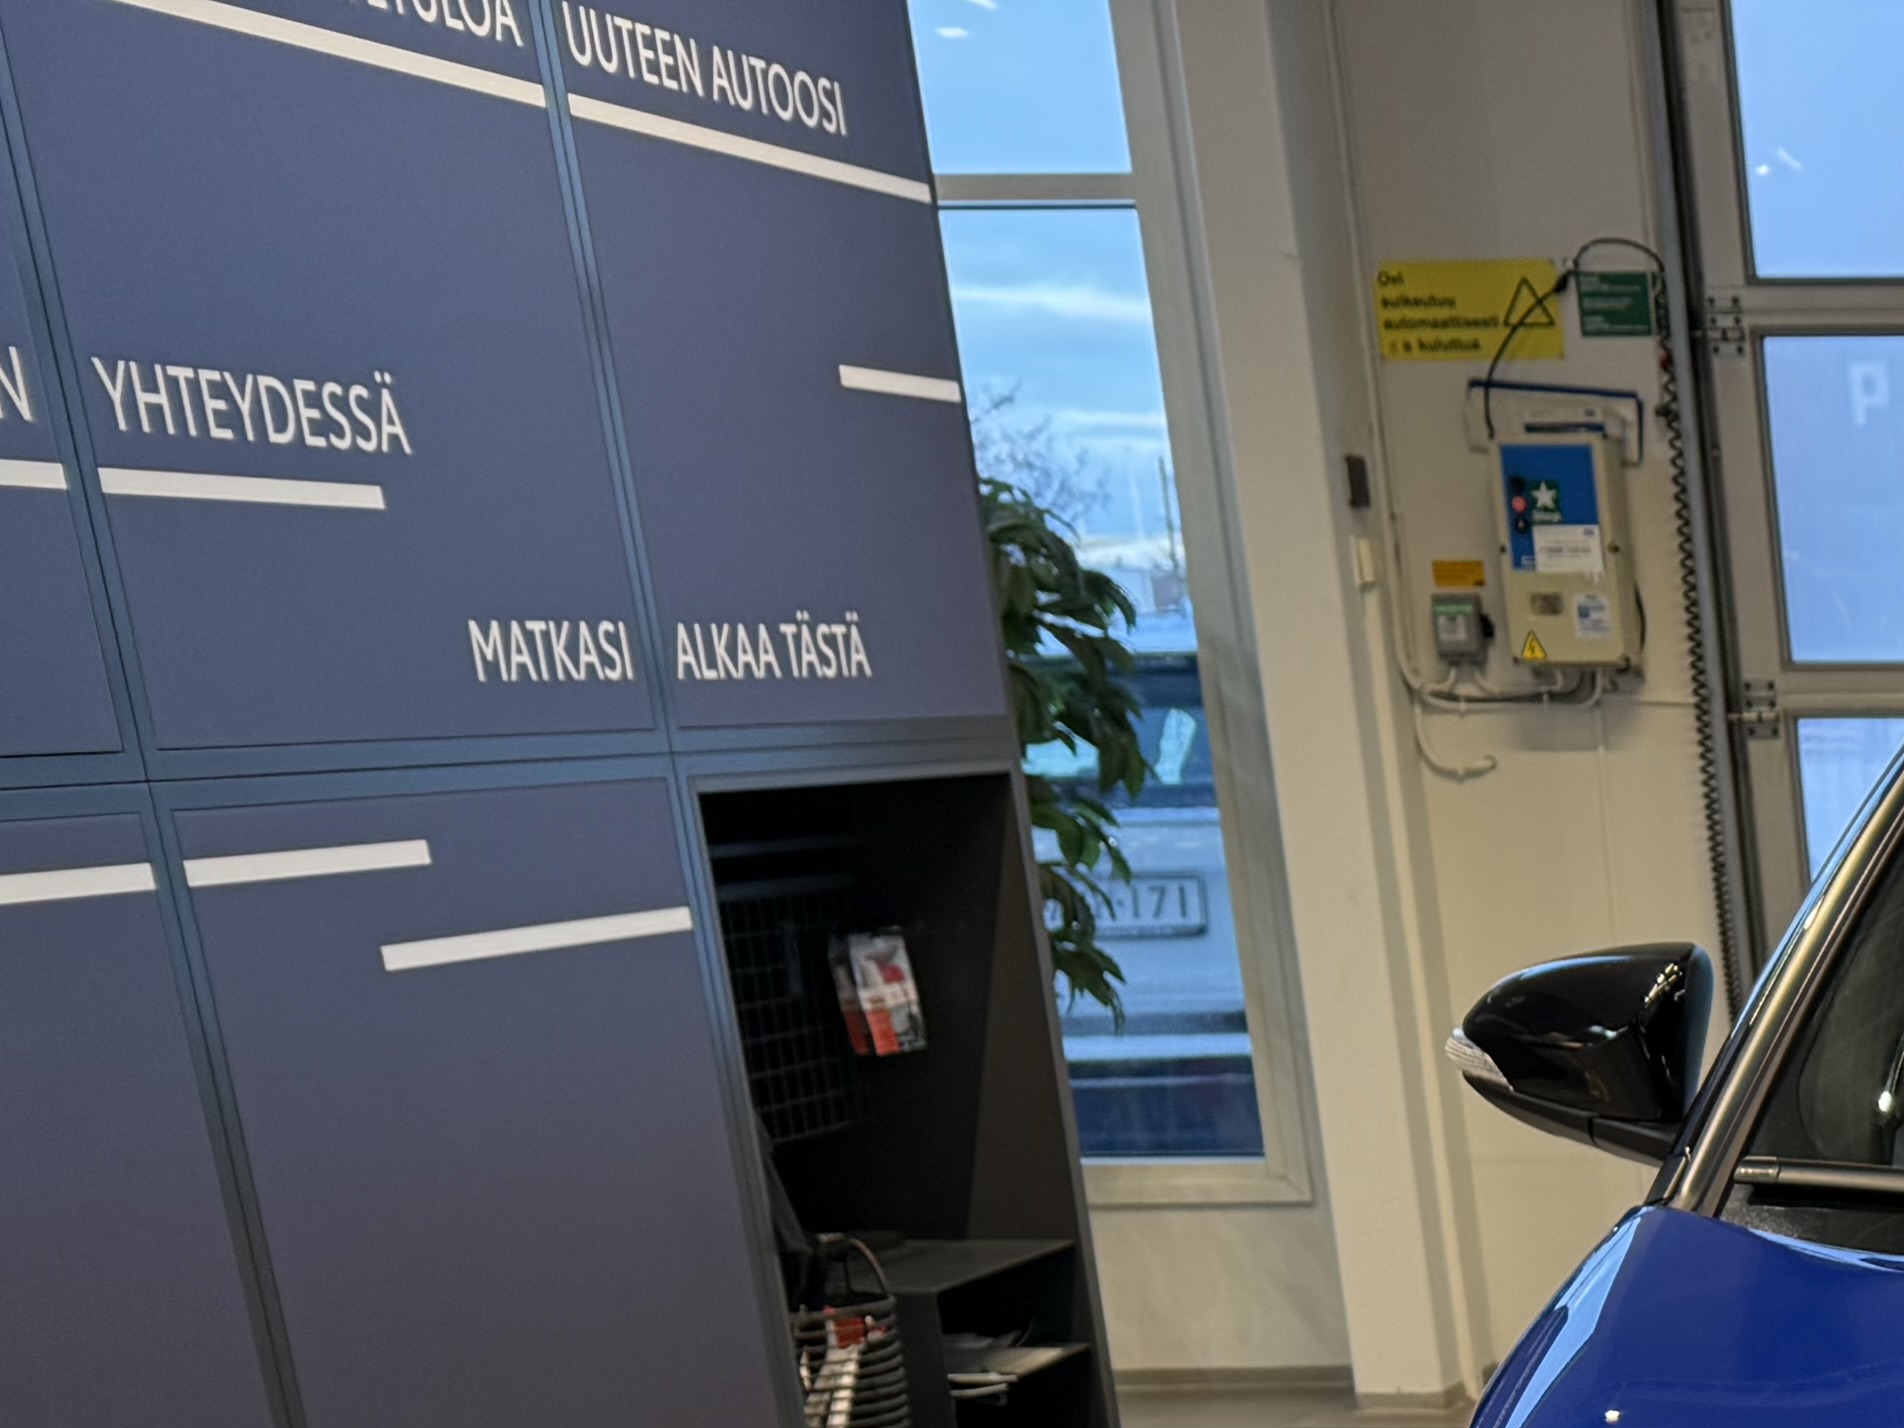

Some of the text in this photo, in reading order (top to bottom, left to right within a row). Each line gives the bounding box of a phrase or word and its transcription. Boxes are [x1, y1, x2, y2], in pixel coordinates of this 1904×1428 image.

[560, 1, 704, 97] UUTEEN
[711, 45, 848, 136] AUTOOSI
[91, 356, 412, 455] YHTEYDESSÄ
[467, 611, 873, 682] MATKASI ALKAA TÄSTÄ
